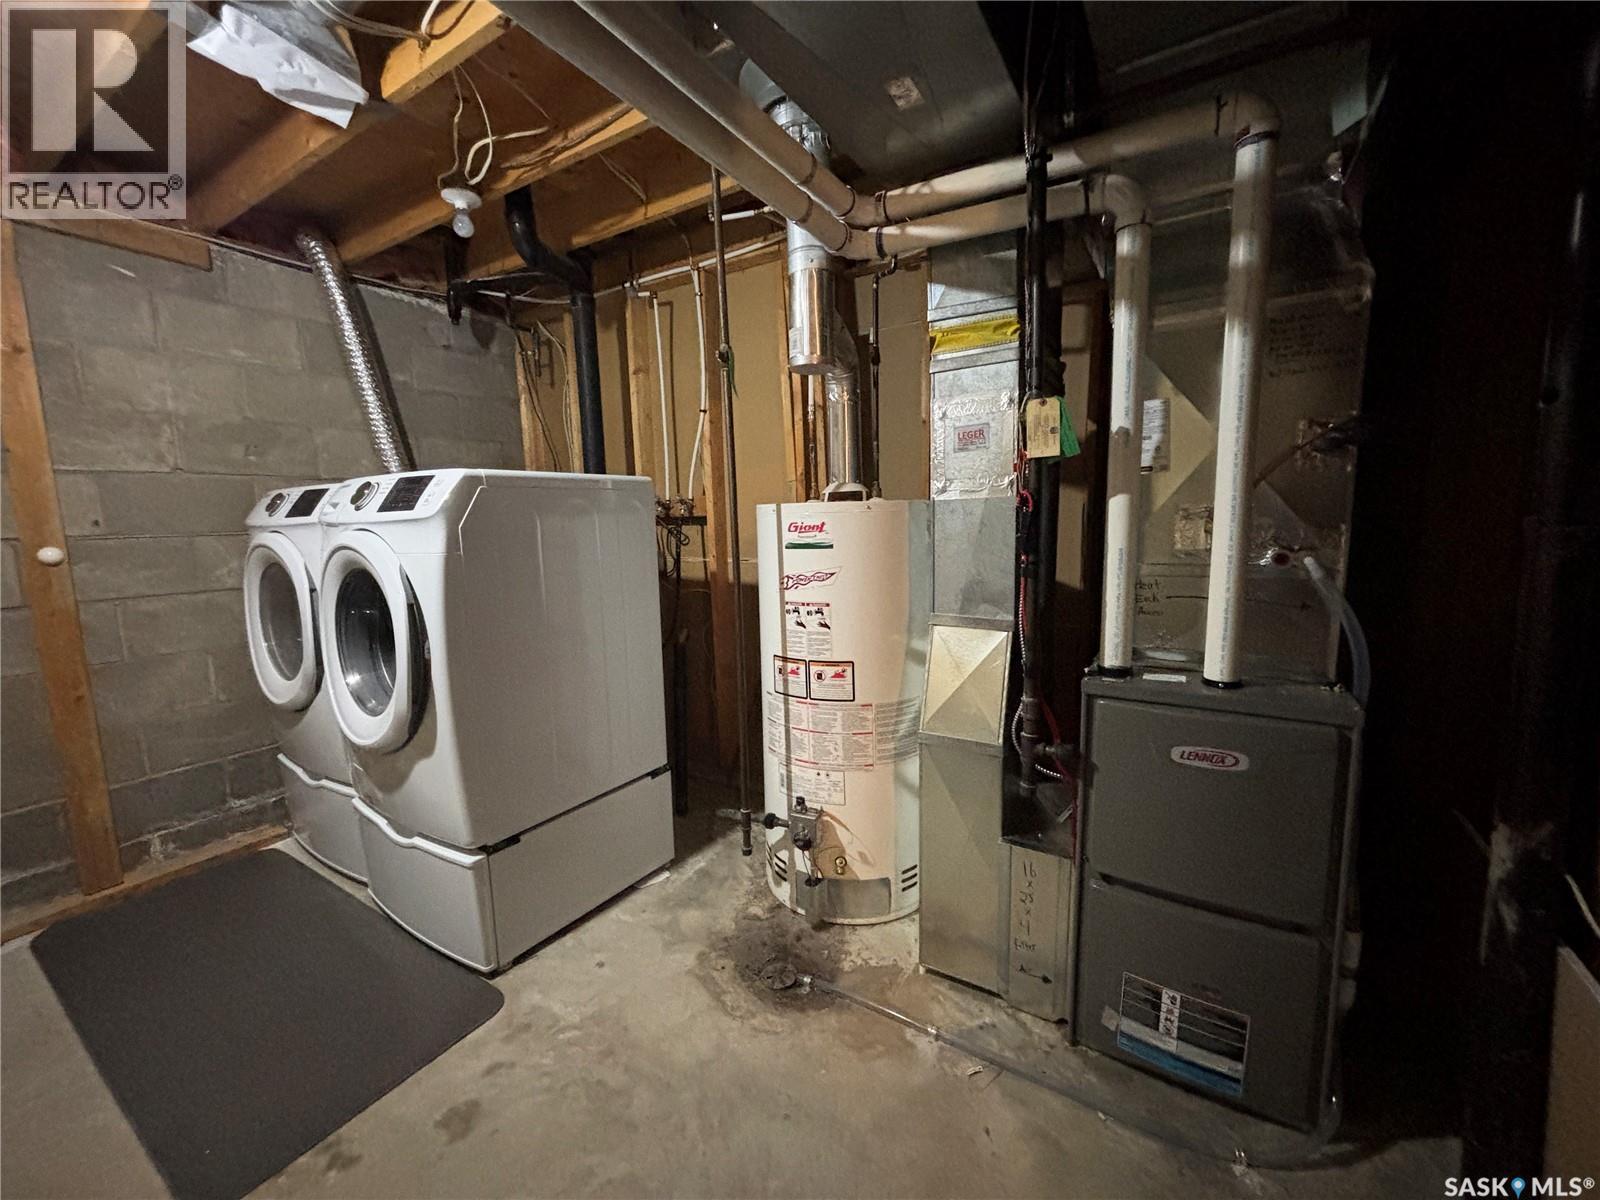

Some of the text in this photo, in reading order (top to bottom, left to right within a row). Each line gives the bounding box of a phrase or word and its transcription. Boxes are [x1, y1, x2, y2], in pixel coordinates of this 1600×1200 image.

[957, 429, 985, 440] LEGER
[787, 521, 826, 534] Giant
[1180, 750, 1228, 765] LENNOX
[1023, 861, 1037, 878] 16
